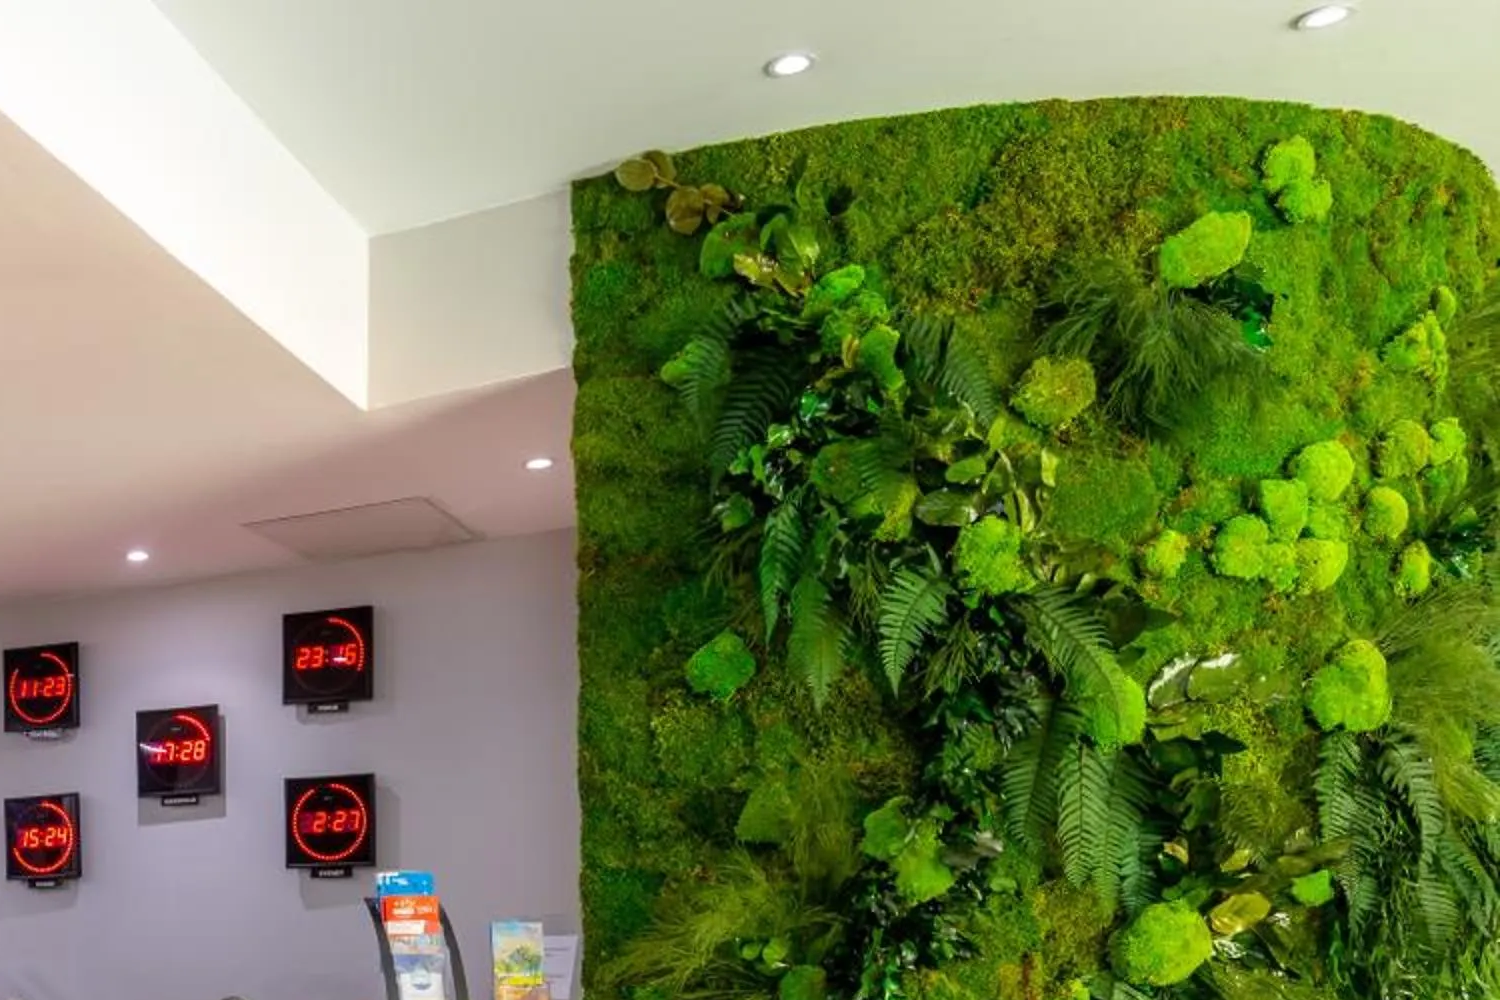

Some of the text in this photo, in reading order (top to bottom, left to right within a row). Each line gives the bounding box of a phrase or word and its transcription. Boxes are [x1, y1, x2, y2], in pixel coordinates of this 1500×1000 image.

[21, 675, 66, 698] 11:23
[156, 740, 206, 762] 17:28
[313, 810, 361, 833] 2:27
[23, 826, 68, 848] 15:24
